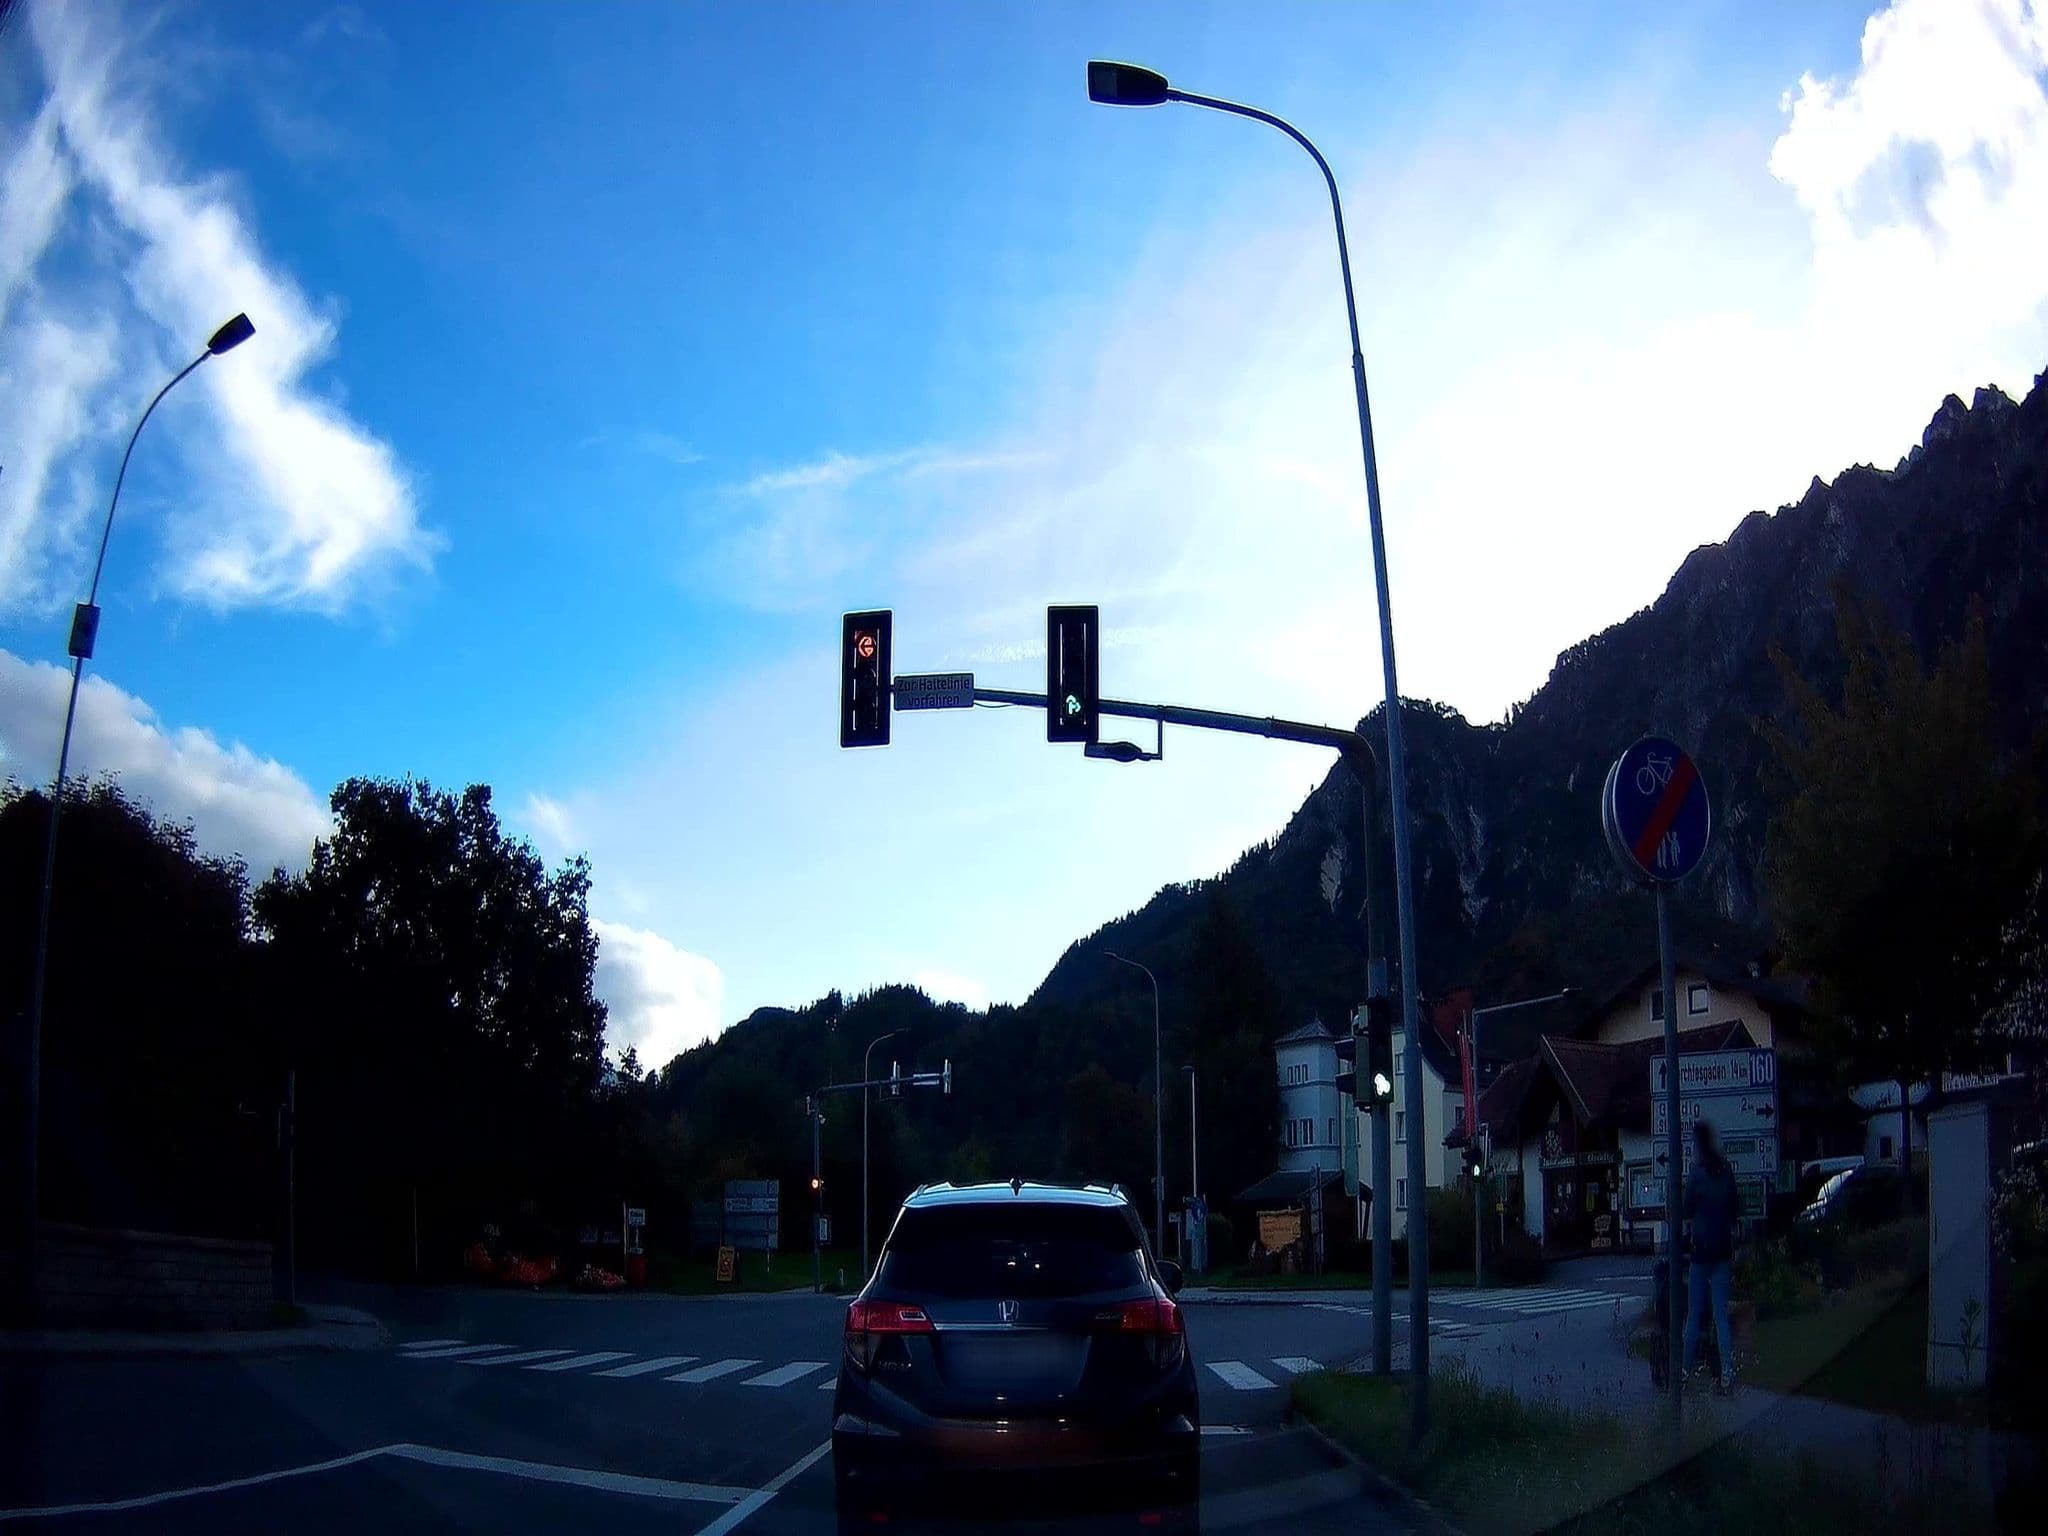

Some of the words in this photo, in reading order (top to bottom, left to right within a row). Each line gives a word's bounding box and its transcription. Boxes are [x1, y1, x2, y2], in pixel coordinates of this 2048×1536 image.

[897, 679, 917, 692] Zur
[919, 677, 970, 691] Haltelinie
[907, 693, 960, 706] vorfahren
[1751, 1053, 1774, 1084] 160
